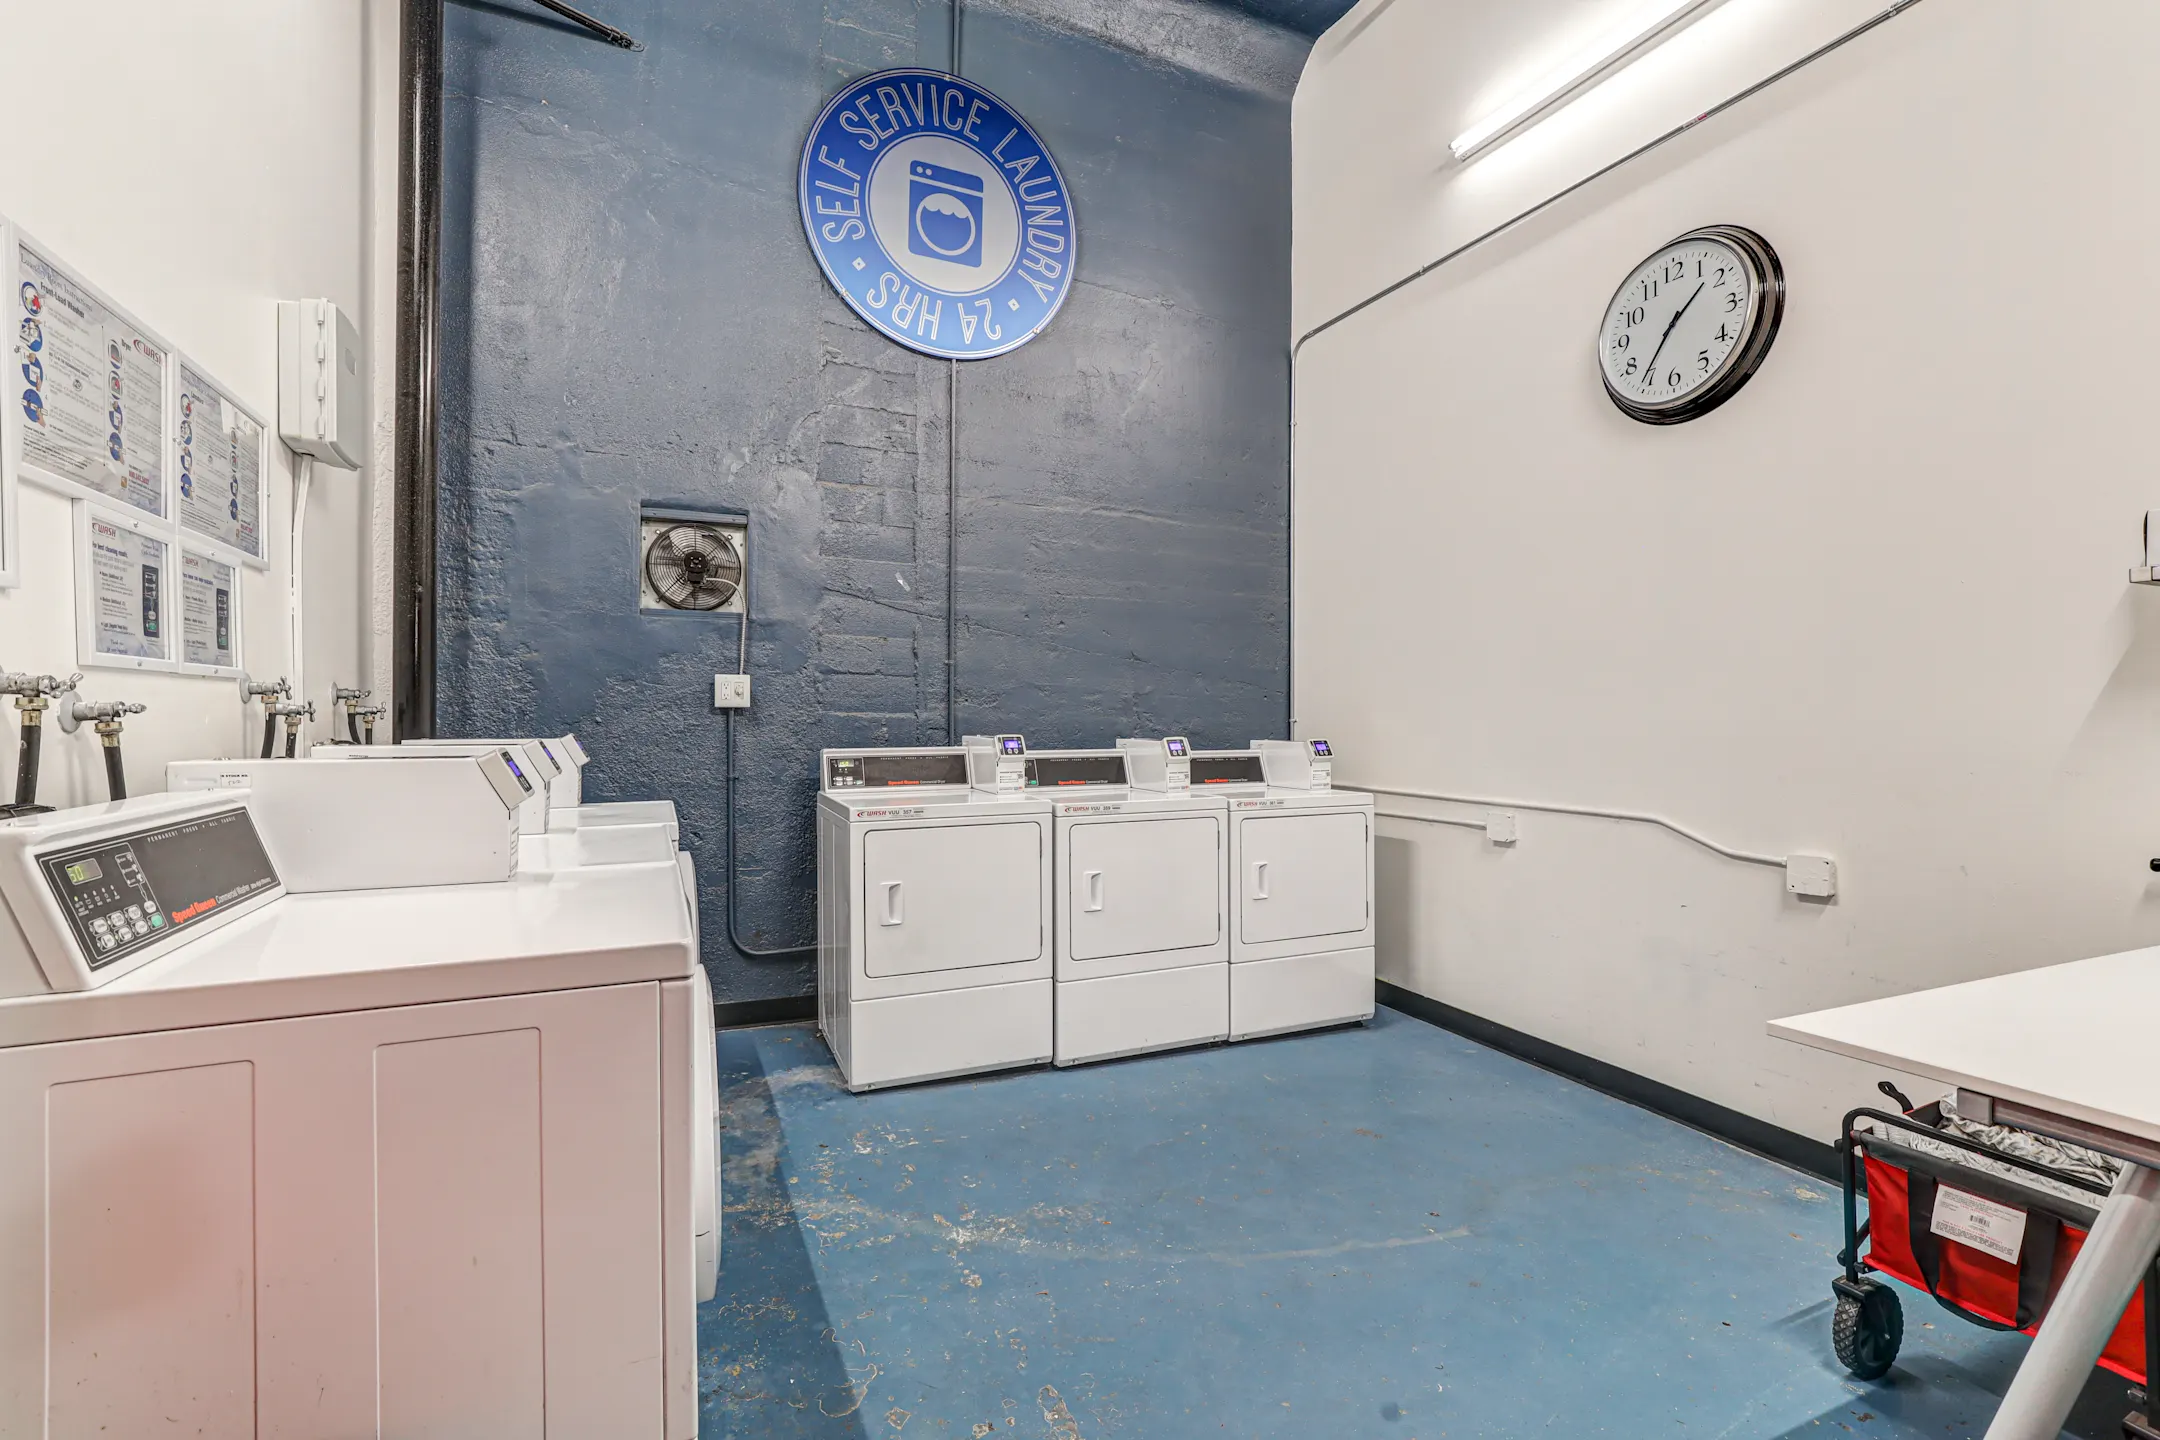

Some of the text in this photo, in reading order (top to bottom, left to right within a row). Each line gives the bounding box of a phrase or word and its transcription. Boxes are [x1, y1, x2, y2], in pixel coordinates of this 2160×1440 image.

[815, 82, 1066, 304] SELF SERVICE LAUNDRY
[1663, 262, 1684, 284] 12
[1696, 260, 1704, 279] 1
[1713, 268, 1726, 289] 2
[1643, 280, 1659, 302] 11
[866, 271, 1002, 345] 24 HRS
[1725, 292, 1738, 313] 3
[1625, 306, 1644, 329] 10
[1714, 323, 1728, 343] 4
[1618, 334, 1630, 354] 9
[1625, 357, 1637, 375] 8
[1697, 349, 1709, 370] 5
[1668, 366, 1681, 387] 6
[147, 830, 179, 843] PERMANENT
[182, 825, 199, 834] PRESS
[172, 903, 197, 923] Speed
[193, 898, 217, 913] Queen
[215, 888, 238, 904] Commercial
